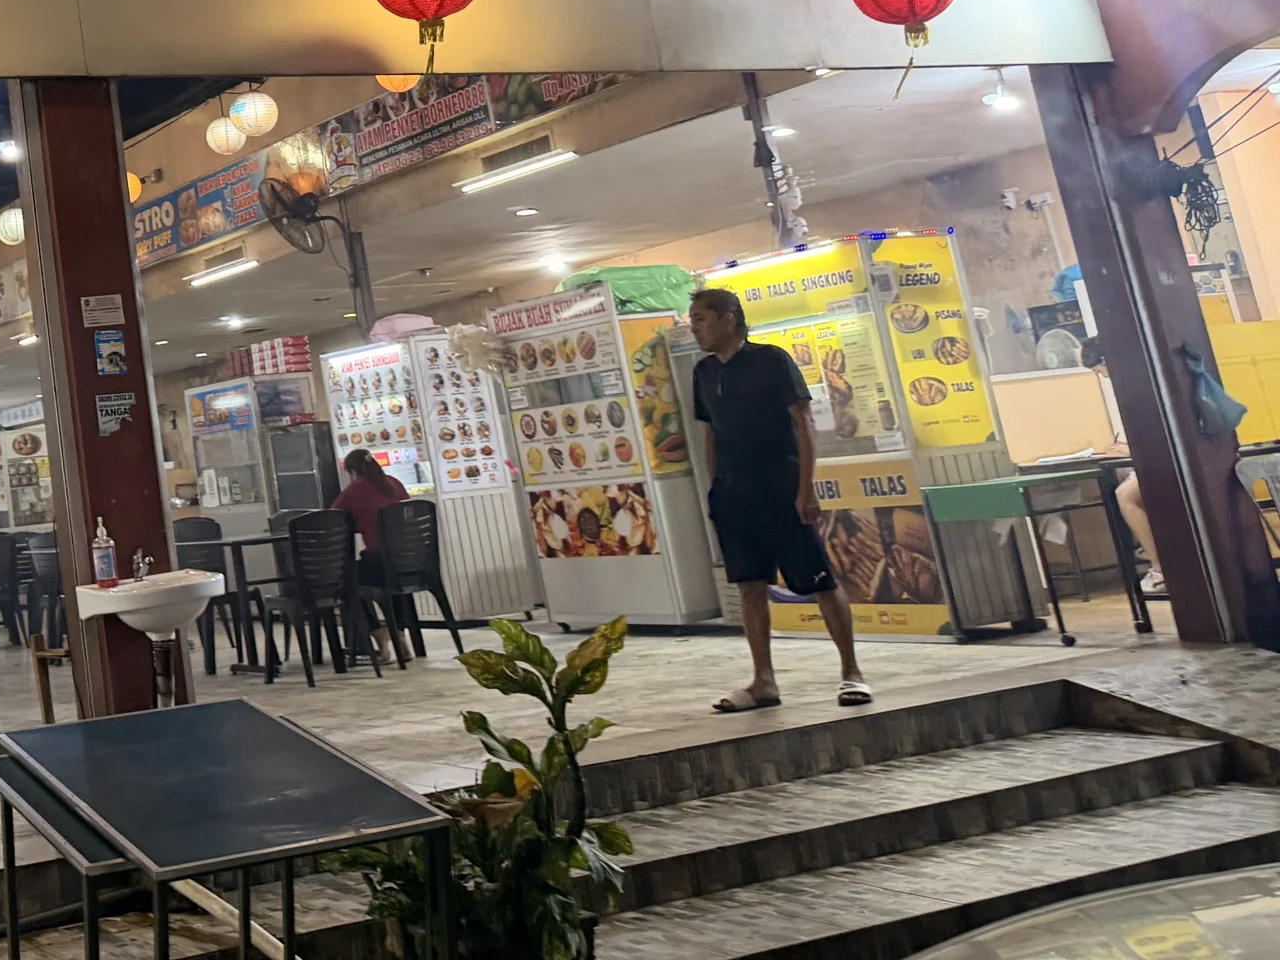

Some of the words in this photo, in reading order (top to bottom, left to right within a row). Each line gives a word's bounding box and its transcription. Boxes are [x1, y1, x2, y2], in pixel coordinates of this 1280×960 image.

[356, 125, 383, 155] AYAM
[383, 109, 423, 143] PENYET
[422, 82, 487, 128] BORNEO888
[394, 148, 424, 169] 0822
[134, 200, 175, 240] STRO
[745, 287, 761, 302] UBI
[767, 281, 796, 298] TALAS
[801, 269, 854, 291] SINGKONG
[899, 272, 941, 287] LEGEND
[493, 310, 526, 335] RUJAK
[525, 303, 553, 328] BUAH
[934, 309, 963, 320] PISANG
[951, 382, 975, 393] TALAS
[98, 407, 130, 418] TANGA
[814, 480, 842, 500] UBI
[859, 475, 908, 497] TALAS
